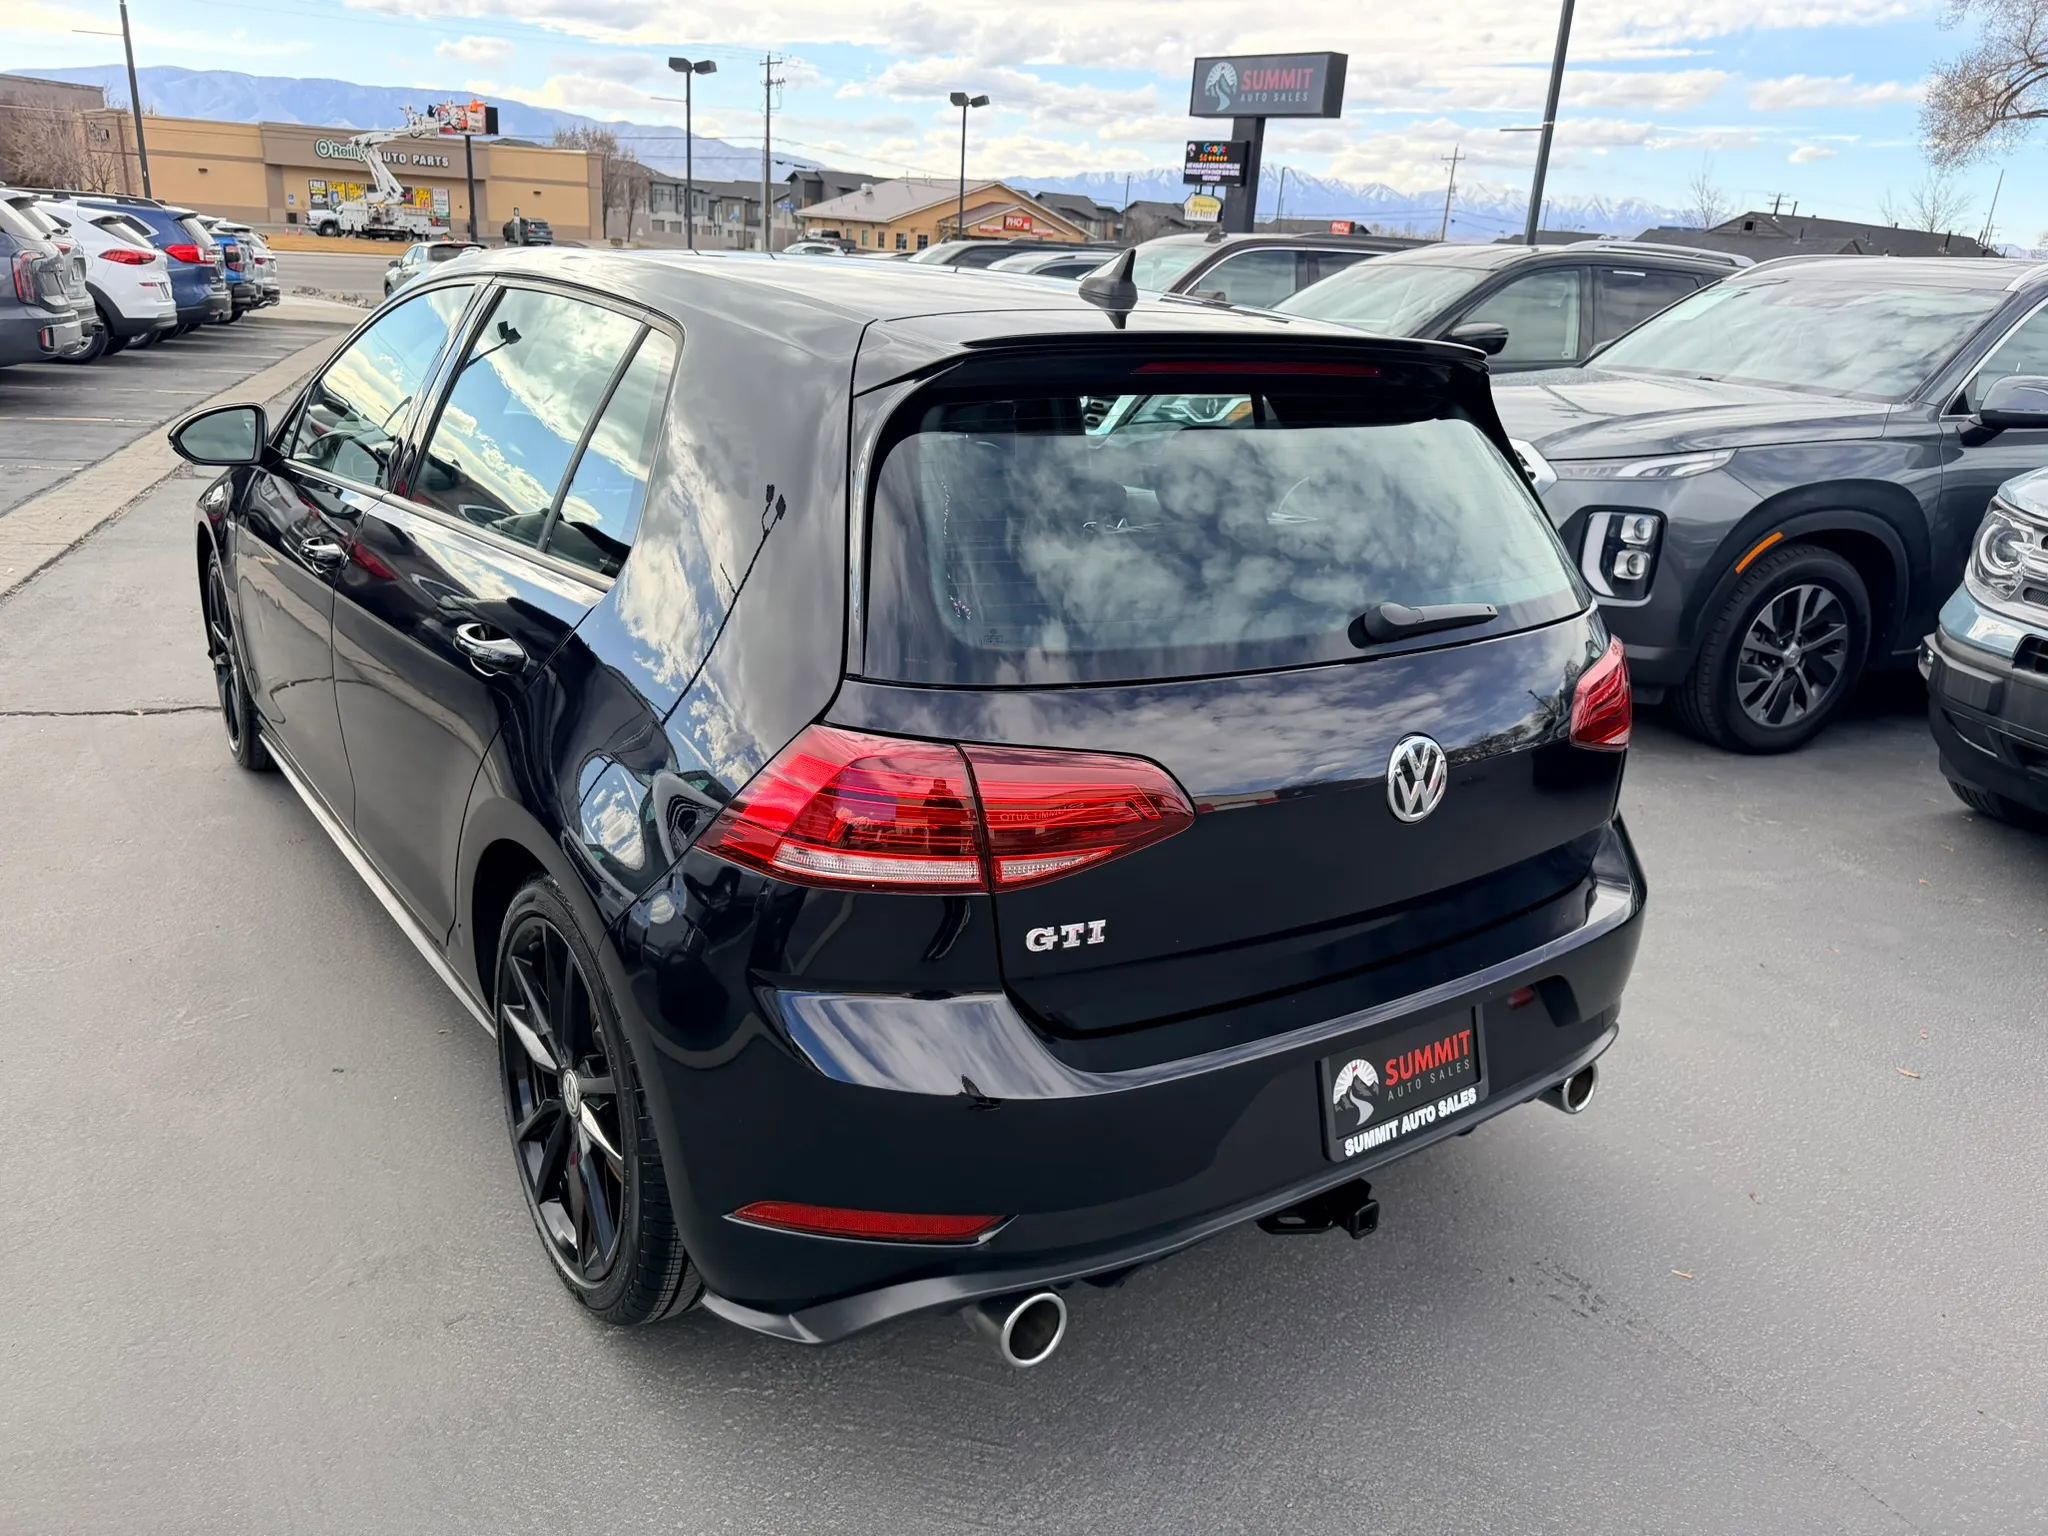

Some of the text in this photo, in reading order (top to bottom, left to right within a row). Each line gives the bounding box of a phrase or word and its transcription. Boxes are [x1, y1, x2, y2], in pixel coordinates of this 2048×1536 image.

[1241, 67, 1313, 91] SUMMIT
[1240, 91, 1308, 102] AUTO SALES
[381, 152, 407, 164] UTO
[412, 154, 449, 167] PARTS
[1203, 143, 1228, 156] Google
[1005, 217, 1023, 227] PHO
[1025, 919, 1107, 953] GTI
[1385, 1030, 1471, 1085] SUMMIT
[1388, 1059, 1470, 1101] AUTO SALES
[1344, 1087, 1477, 1156] SUMMIT AUTO SALES
